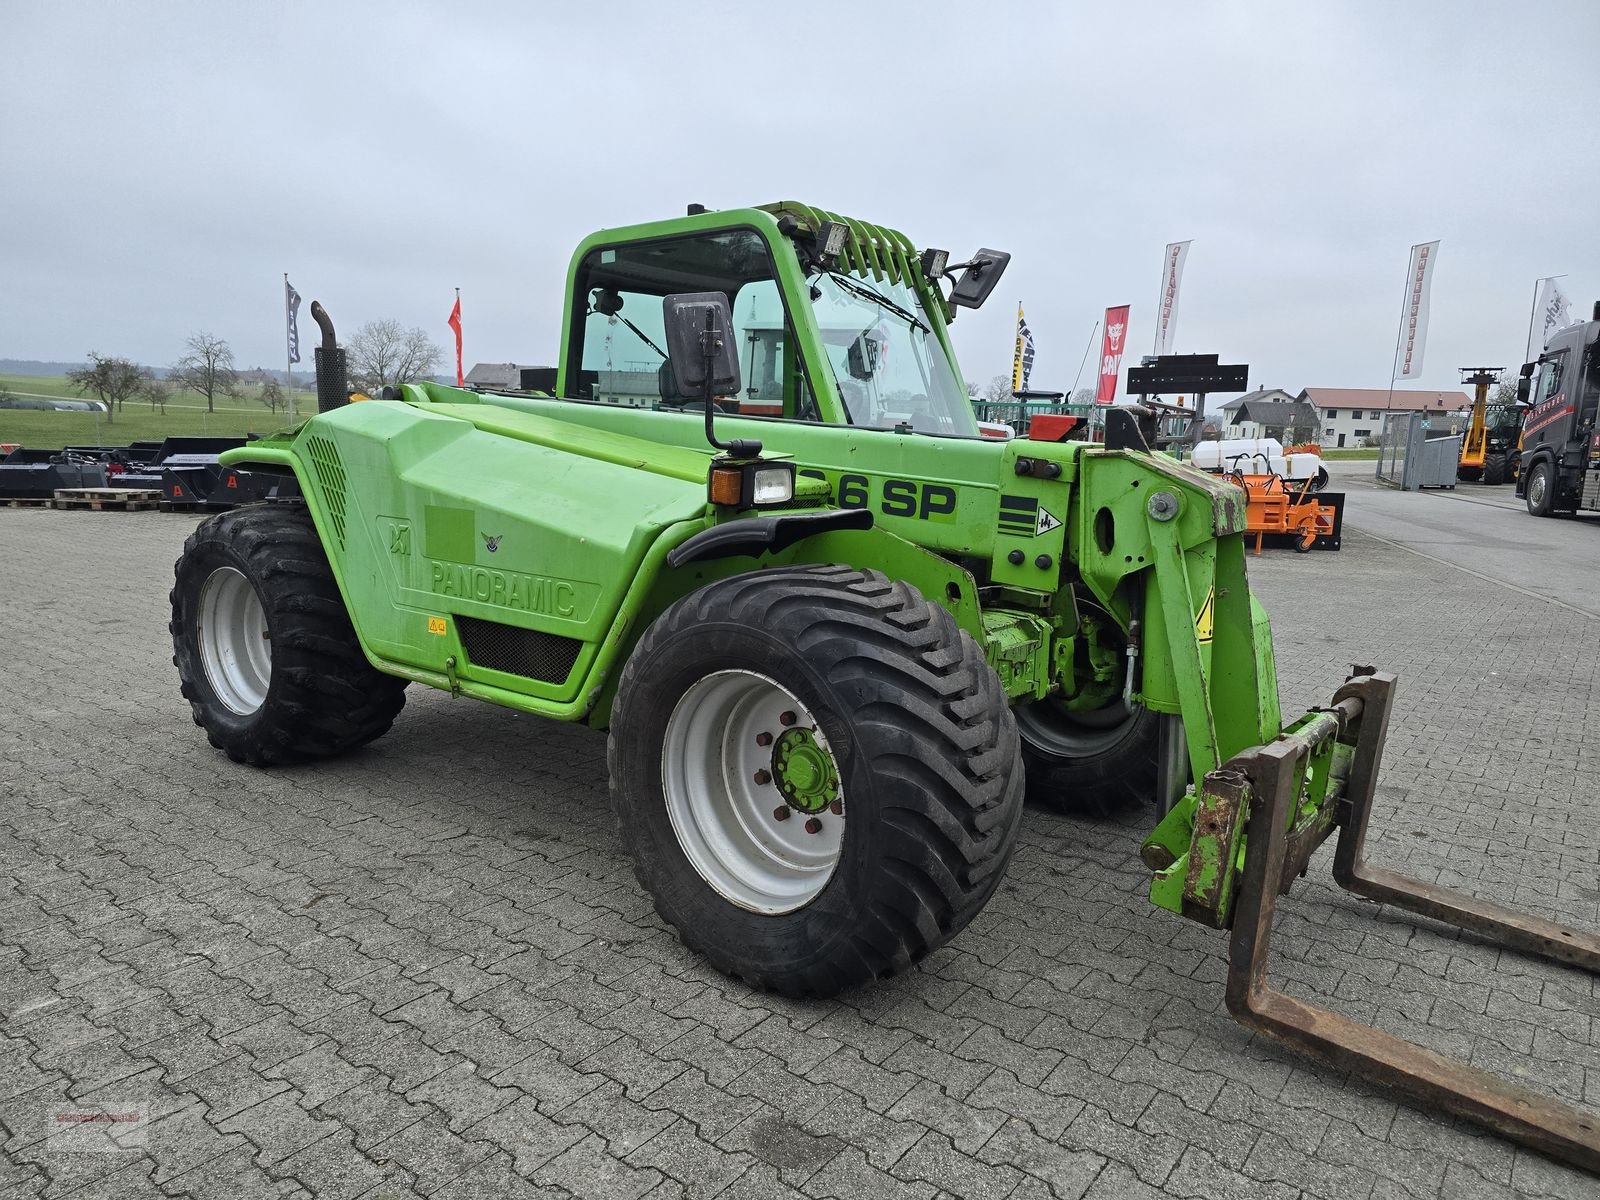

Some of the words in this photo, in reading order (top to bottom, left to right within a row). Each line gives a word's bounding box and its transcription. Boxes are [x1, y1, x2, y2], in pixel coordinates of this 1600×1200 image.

[173, 485, 184, 498] A
[227, 475, 238, 489] A
[881, 480, 956, 520] SP
[431, 561, 575, 617] PANORAMIC
